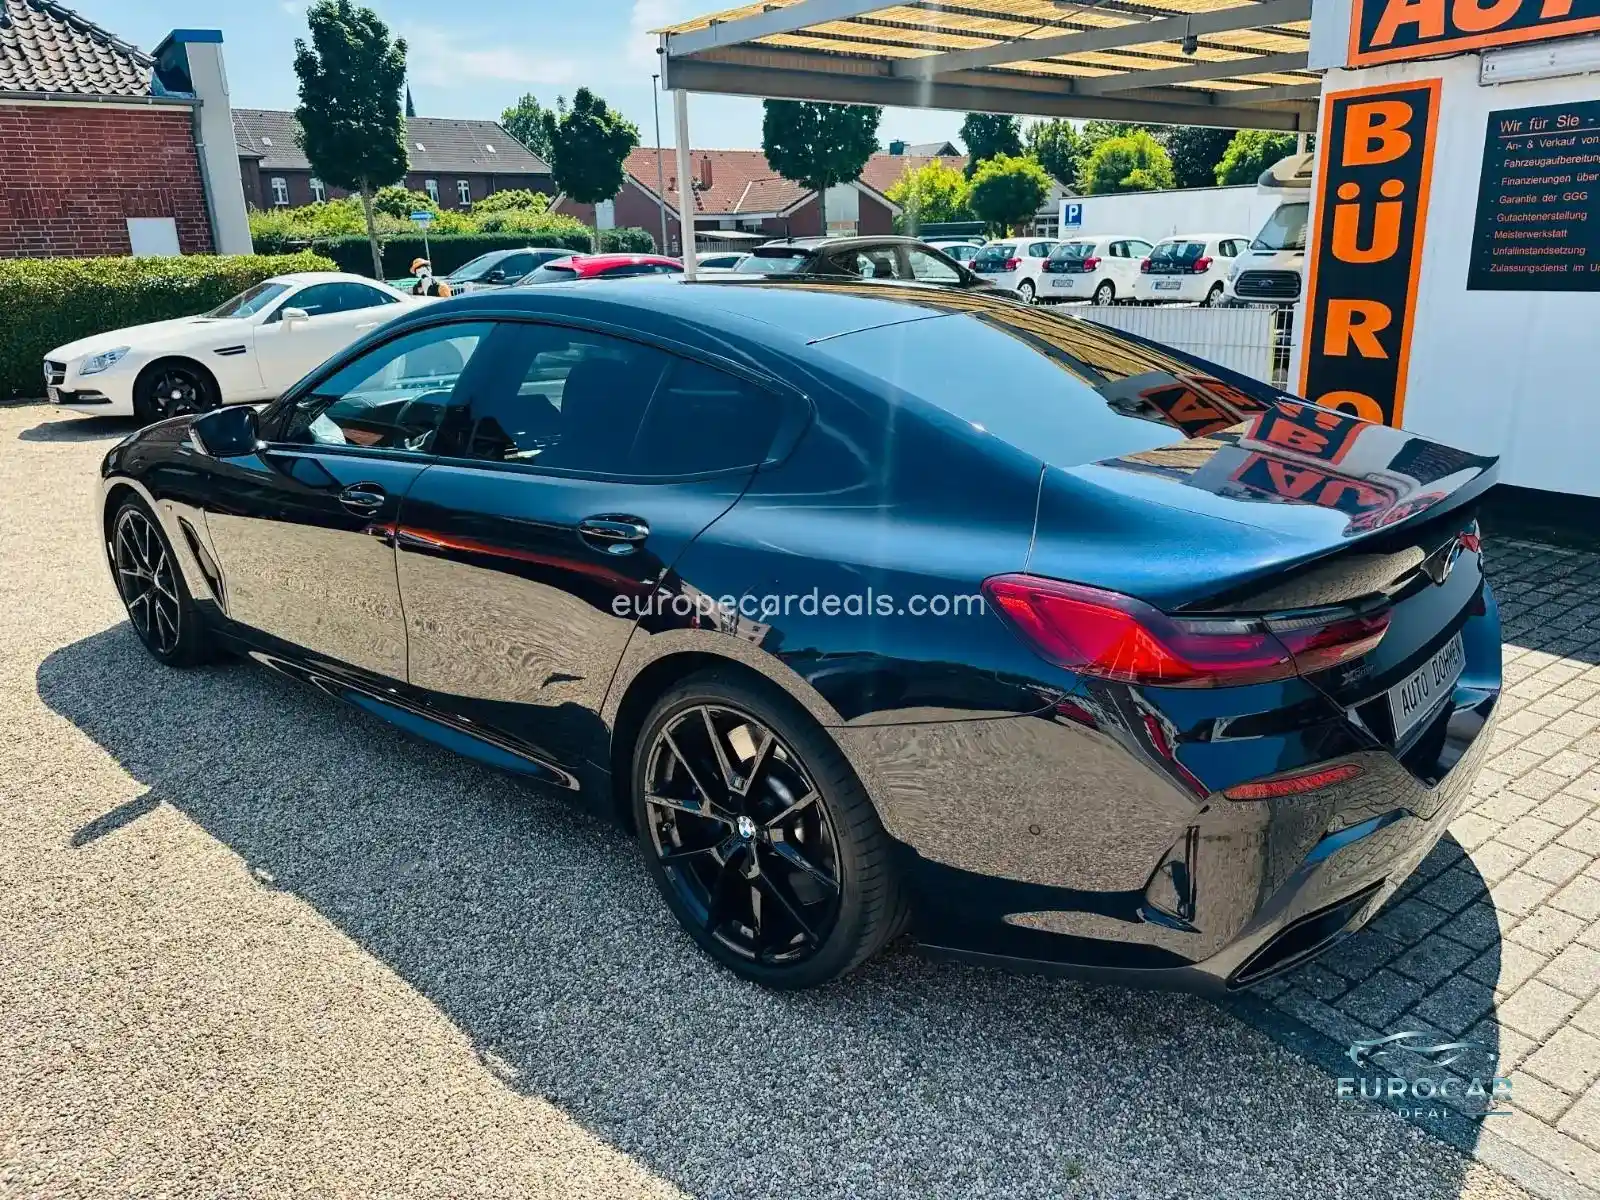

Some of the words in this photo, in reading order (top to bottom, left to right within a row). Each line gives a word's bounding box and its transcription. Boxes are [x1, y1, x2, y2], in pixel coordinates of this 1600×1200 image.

[1500, 119, 1522, 132] Wir
[1529, 116, 1549, 131] für
[1556, 114, 1580, 128] Sie
[1526, 139, 1534, 149] &
[1540, 136, 1577, 148] Verkauf
[1501, 174, 1571, 186] Finanzierungen
[1576, 172, 1600, 182] über
[1499, 194, 1537, 204] Garantie
[1542, 193, 1558, 203] der
[1562, 192, 1588, 201] GGG
[1069, 204, 1079, 222] P
[1496, 211, 1588, 222] Gutachtenerstellung
[1494, 228, 1568, 239] Meisterwerkstatt
[1492, 246, 1586, 256] Unfallinstandsetzung
[1489, 263, 1568, 274] Zulassungsdienst
[1572, 263, 1585, 272] im
[1401, 672, 1429, 717] AUTO
